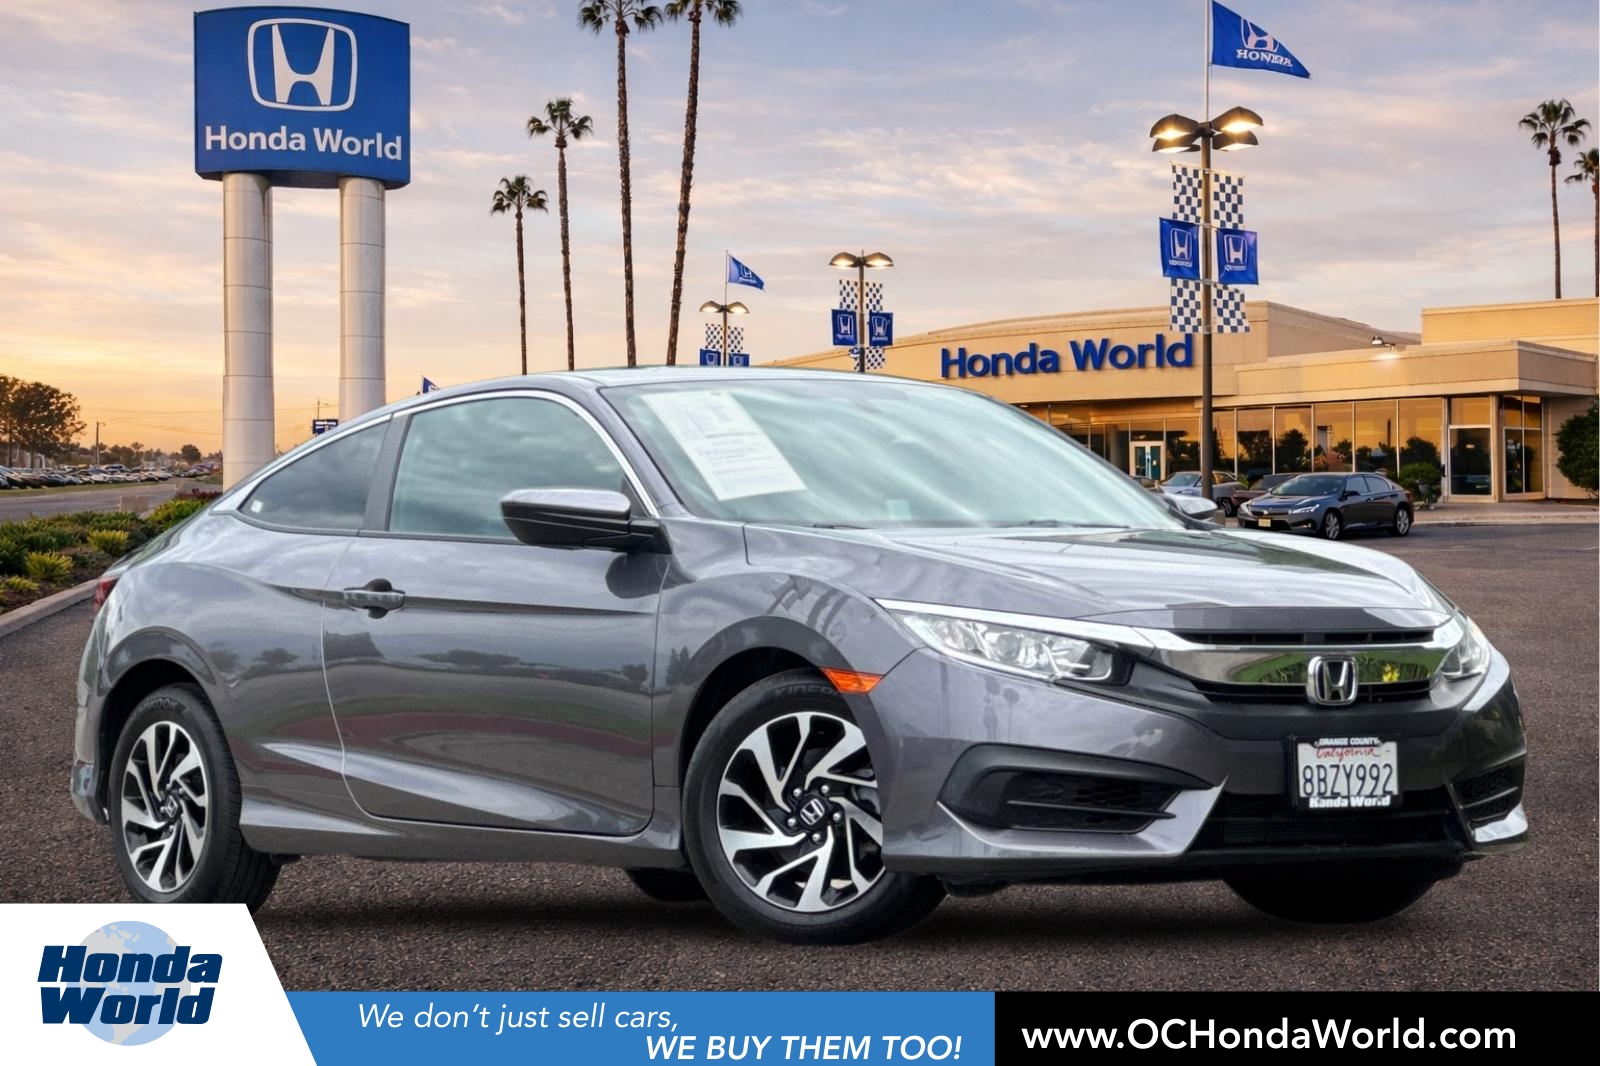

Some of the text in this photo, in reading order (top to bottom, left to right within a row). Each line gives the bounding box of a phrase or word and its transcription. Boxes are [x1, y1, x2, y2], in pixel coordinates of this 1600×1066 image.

[205, 125, 402, 160] Honda World
[941, 333, 1194, 377] Honda World
[1319, 737, 1379, 746] ORANGE COUNTY
[1316, 747, 1379, 762] California
[1303, 764, 1392, 797] 8BZY992
[1350, 794, 1391, 807] World
